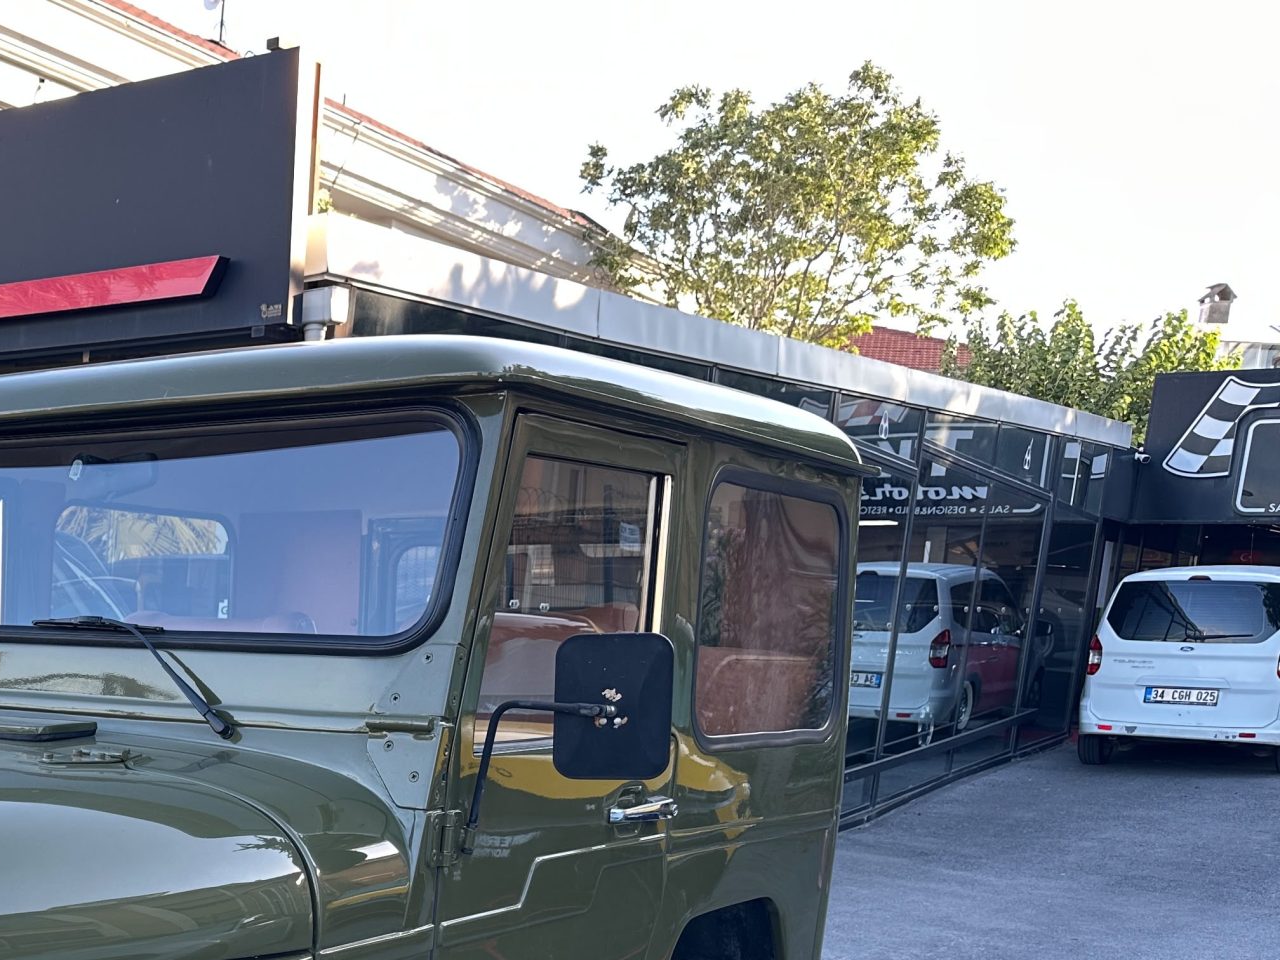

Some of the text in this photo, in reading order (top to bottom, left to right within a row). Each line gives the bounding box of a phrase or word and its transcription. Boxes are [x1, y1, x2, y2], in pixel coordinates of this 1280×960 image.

[1152, 689, 1216, 702] 34 CGH 025
